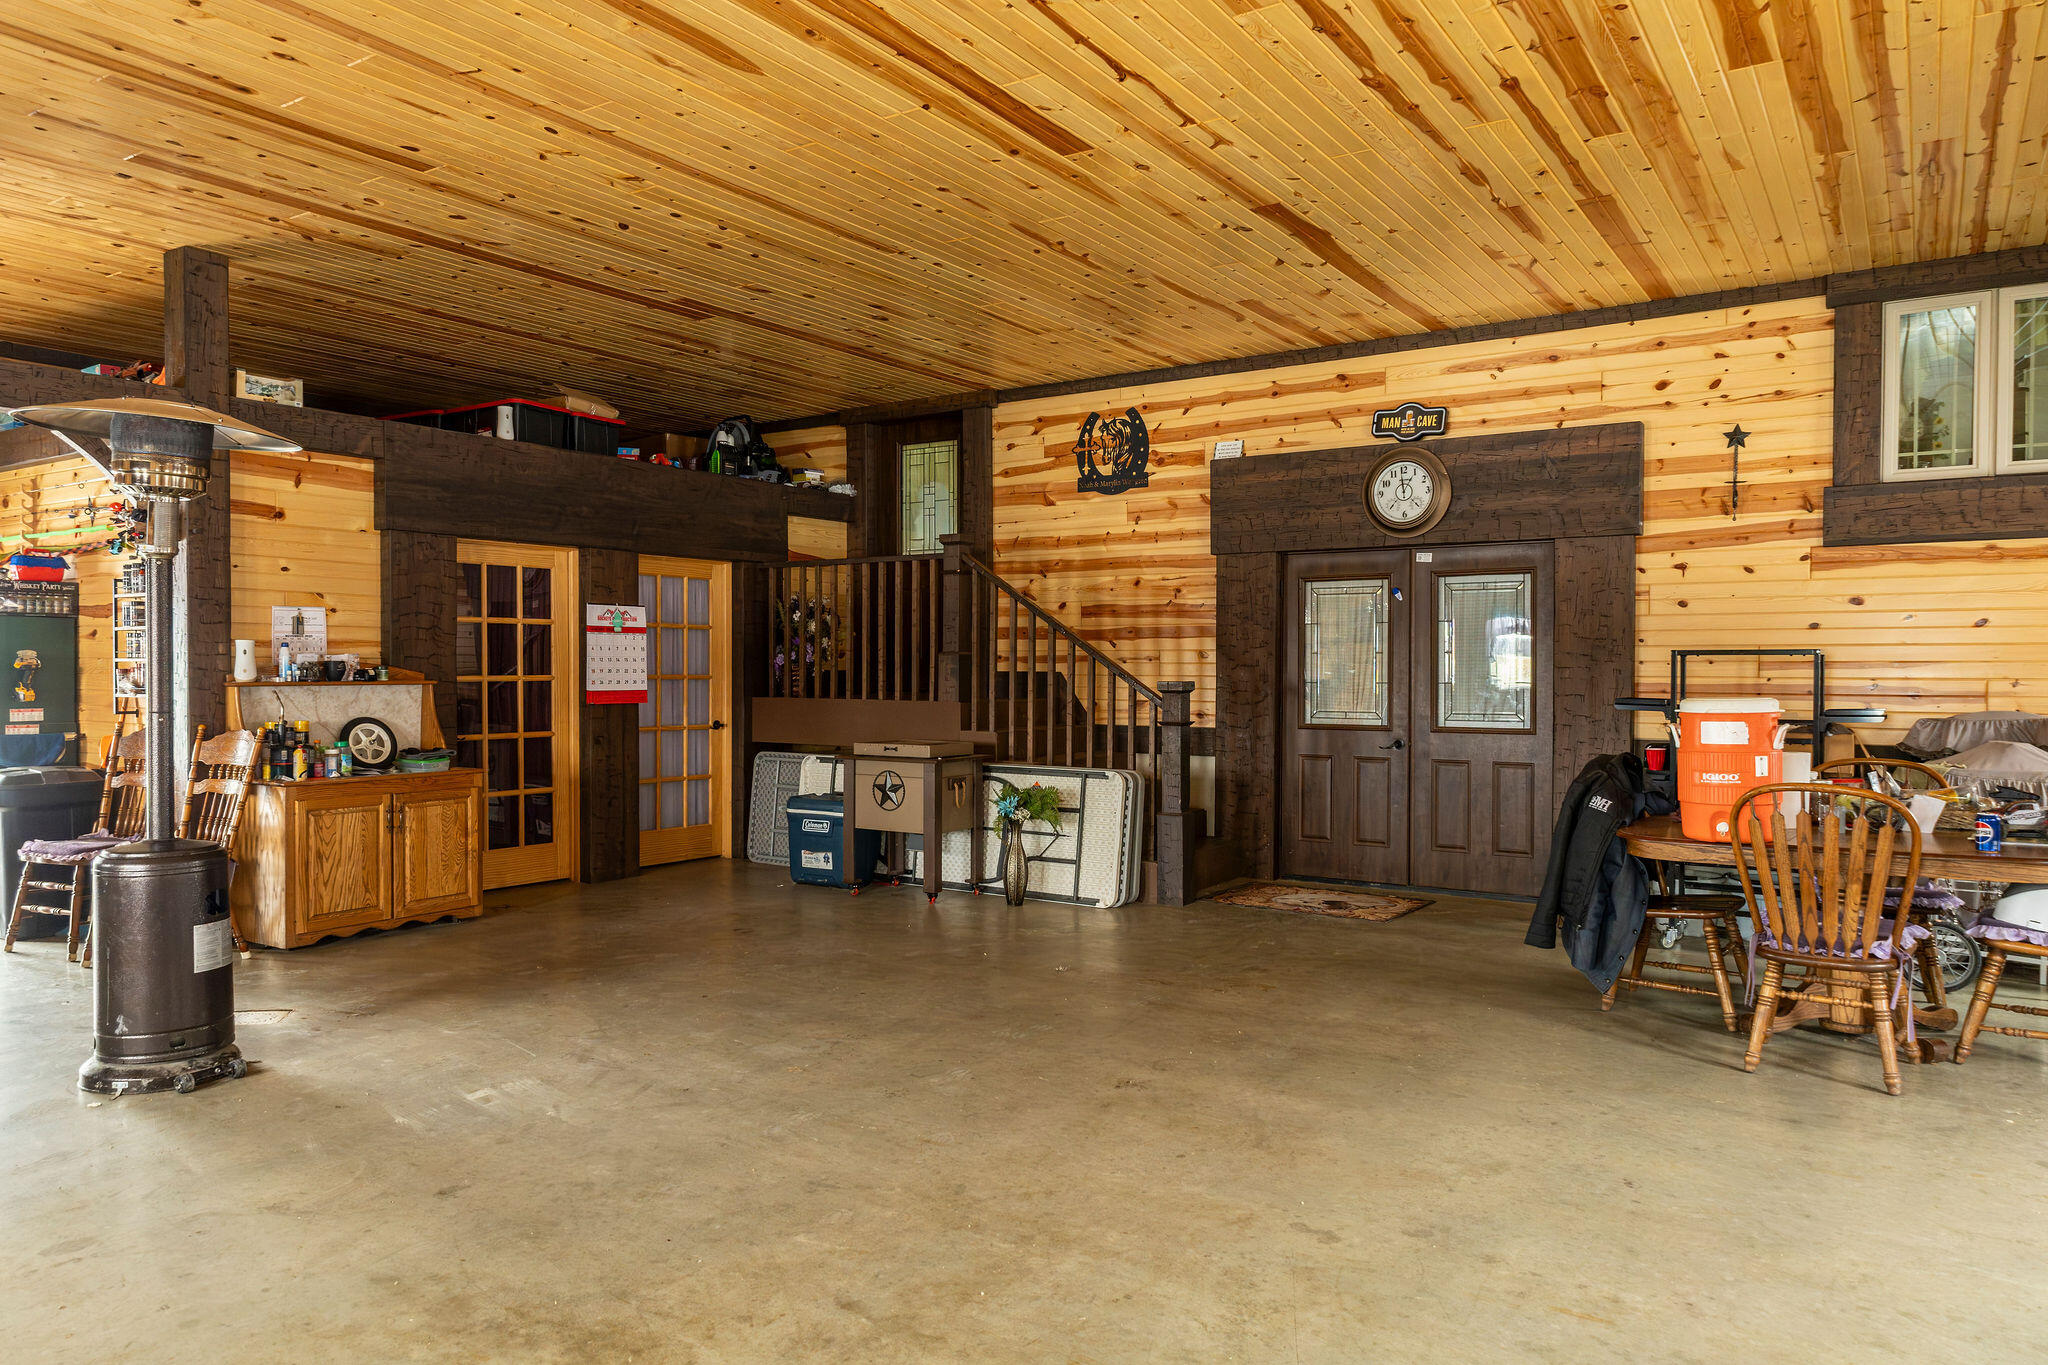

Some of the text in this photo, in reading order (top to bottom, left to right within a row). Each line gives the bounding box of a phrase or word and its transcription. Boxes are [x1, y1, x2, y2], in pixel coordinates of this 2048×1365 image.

[1381, 414, 1438, 428] MAN CAVE
[1390, 470, 1397, 478] 11
[1400, 466, 1408, 474] 12
[1413, 468, 1417, 476] 1
[1421, 474, 1427, 483] 2
[1382, 480, 1391, 488] 10
[1425, 485, 1431, 494] 3
[1378, 490, 1384, 498] 9
[1402, 510, 1408, 518] 6
[40, 581, 61, 591] PARTY
[1702, 772, 1739, 781] IGLOO
